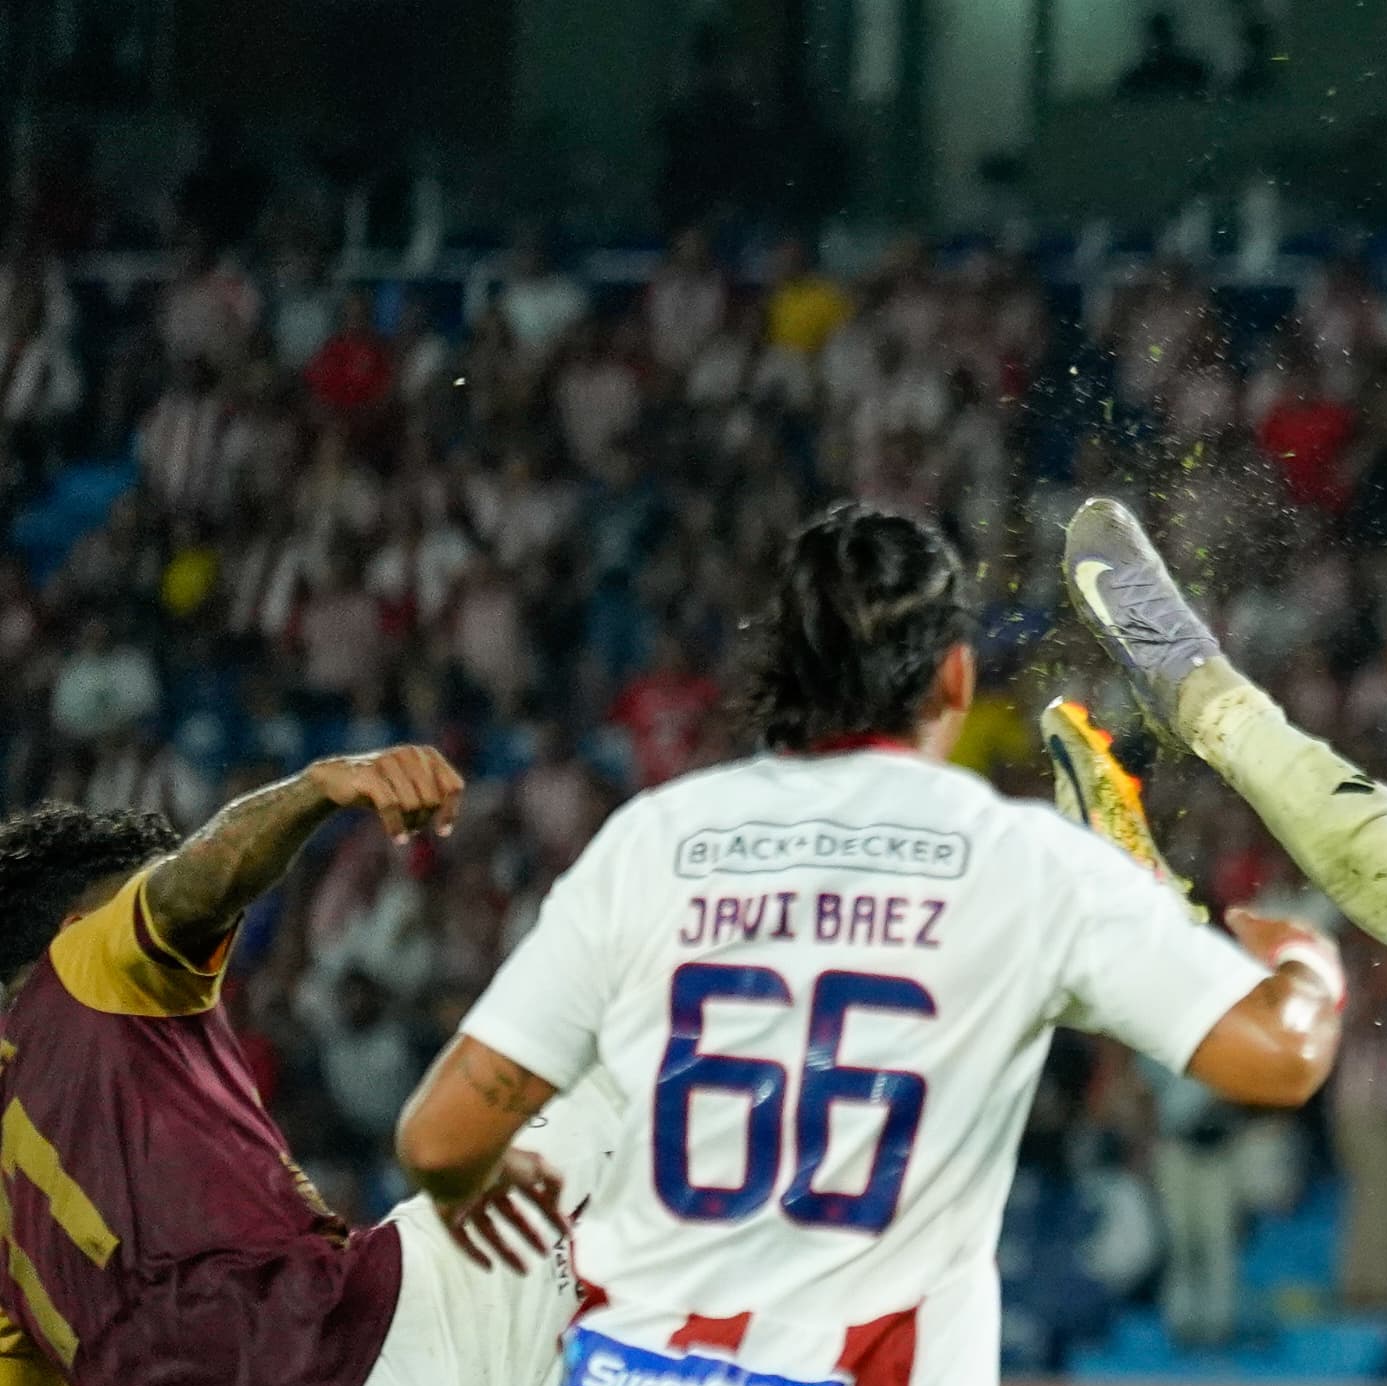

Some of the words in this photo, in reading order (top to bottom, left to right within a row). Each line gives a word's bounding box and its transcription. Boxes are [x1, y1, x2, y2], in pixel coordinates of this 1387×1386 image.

[679, 890, 798, 947] JAVI
[814, 892, 947, 947] BAEZ
[650, 961, 937, 1235] 66
